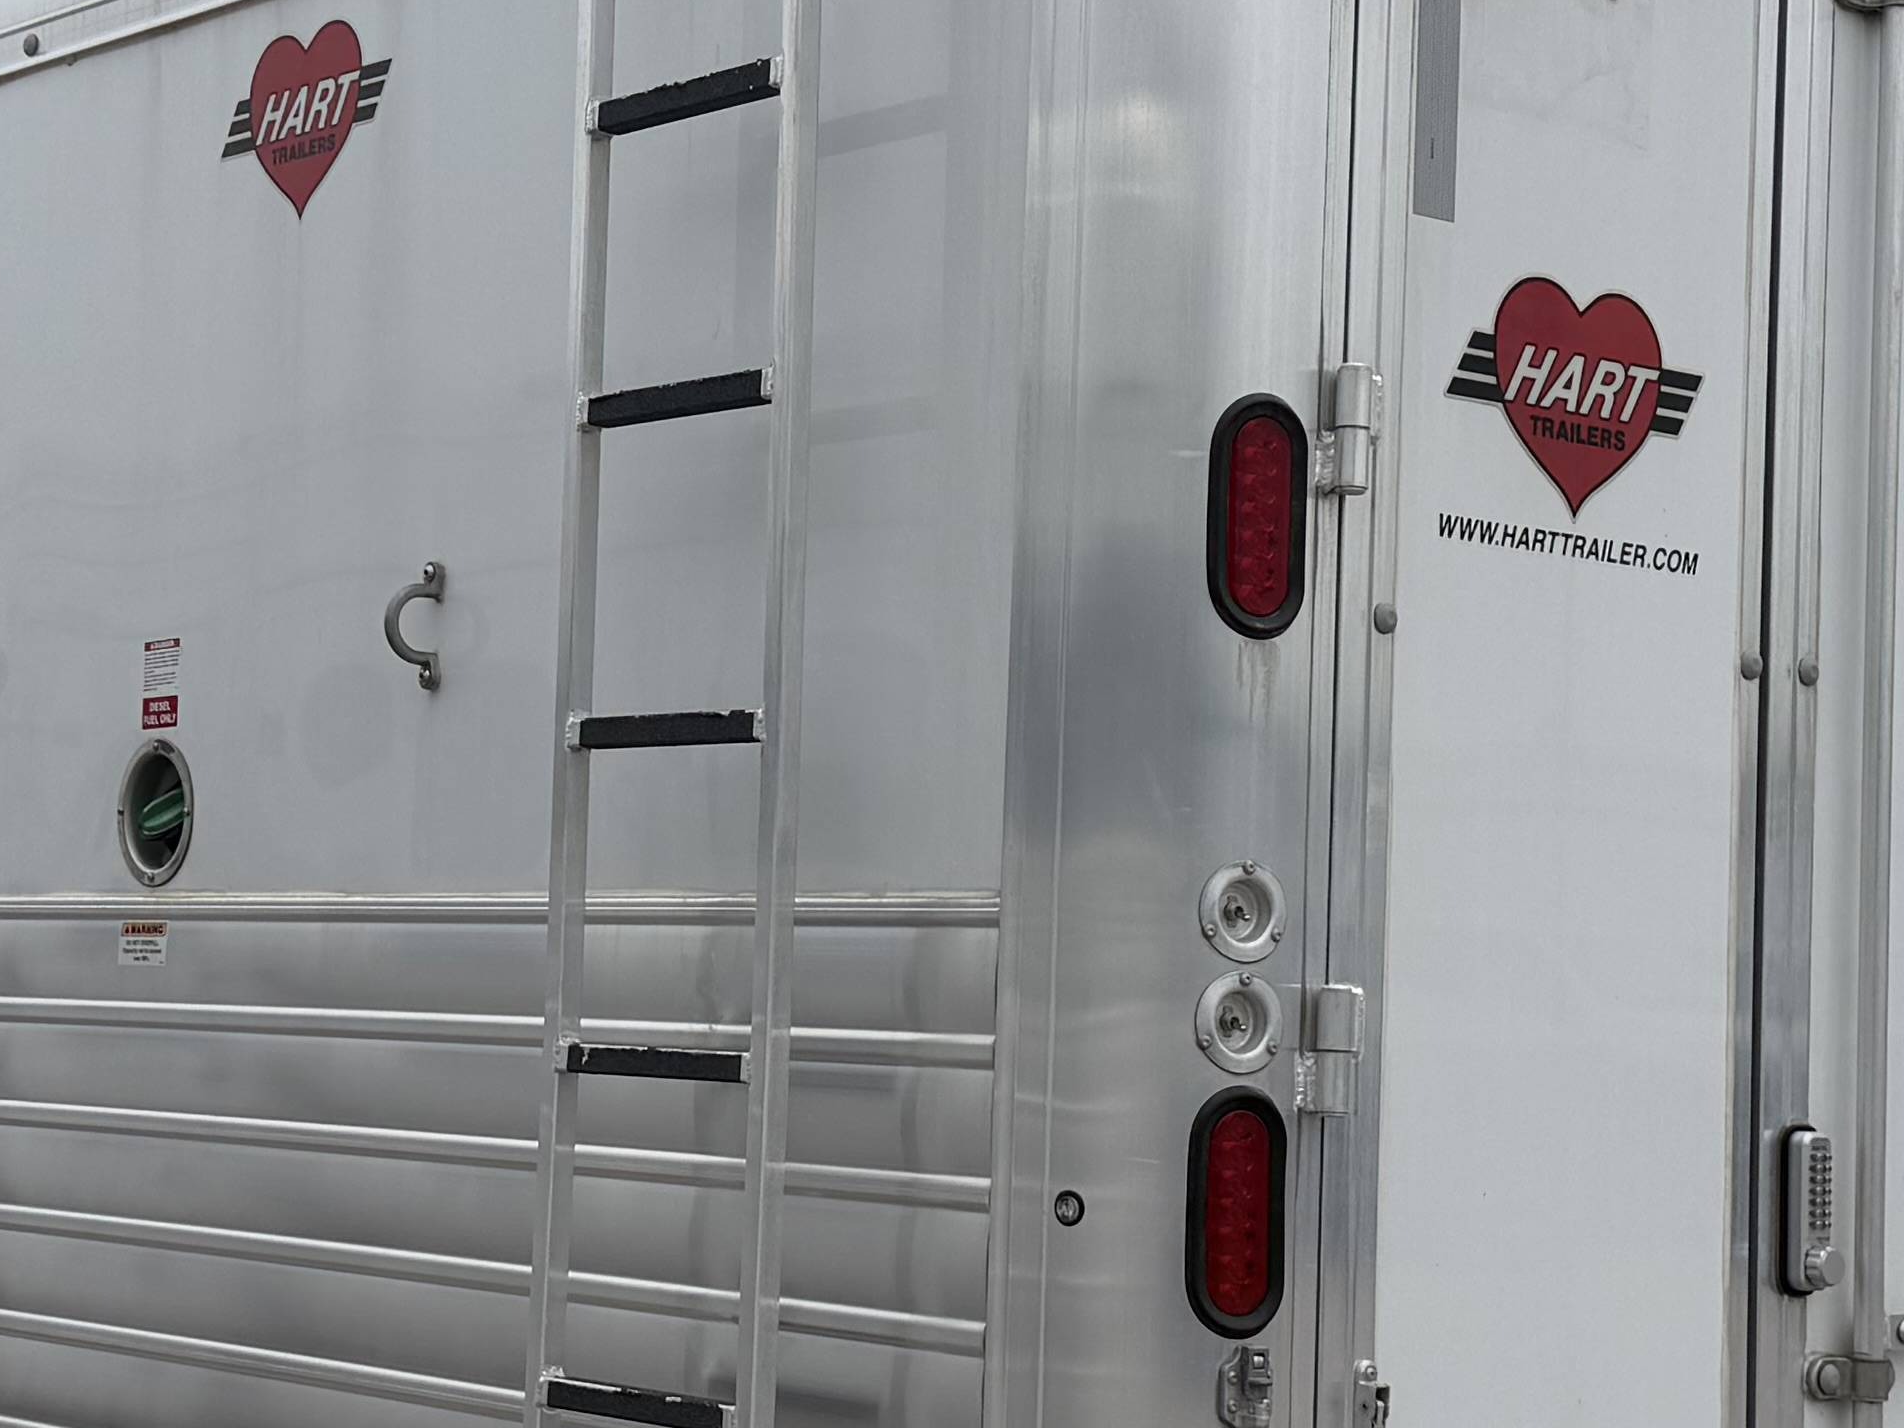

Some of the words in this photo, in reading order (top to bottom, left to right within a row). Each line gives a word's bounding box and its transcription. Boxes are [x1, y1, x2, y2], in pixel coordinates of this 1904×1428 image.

[256, 69, 361, 147] HART
[272, 133, 336, 166] TRAILERS
[1503, 342, 1660, 425] HART
[1529, 414, 1627, 452] TRAILERS
[1438, 512, 1700, 576] WWW.HARTTRAILER.COM
